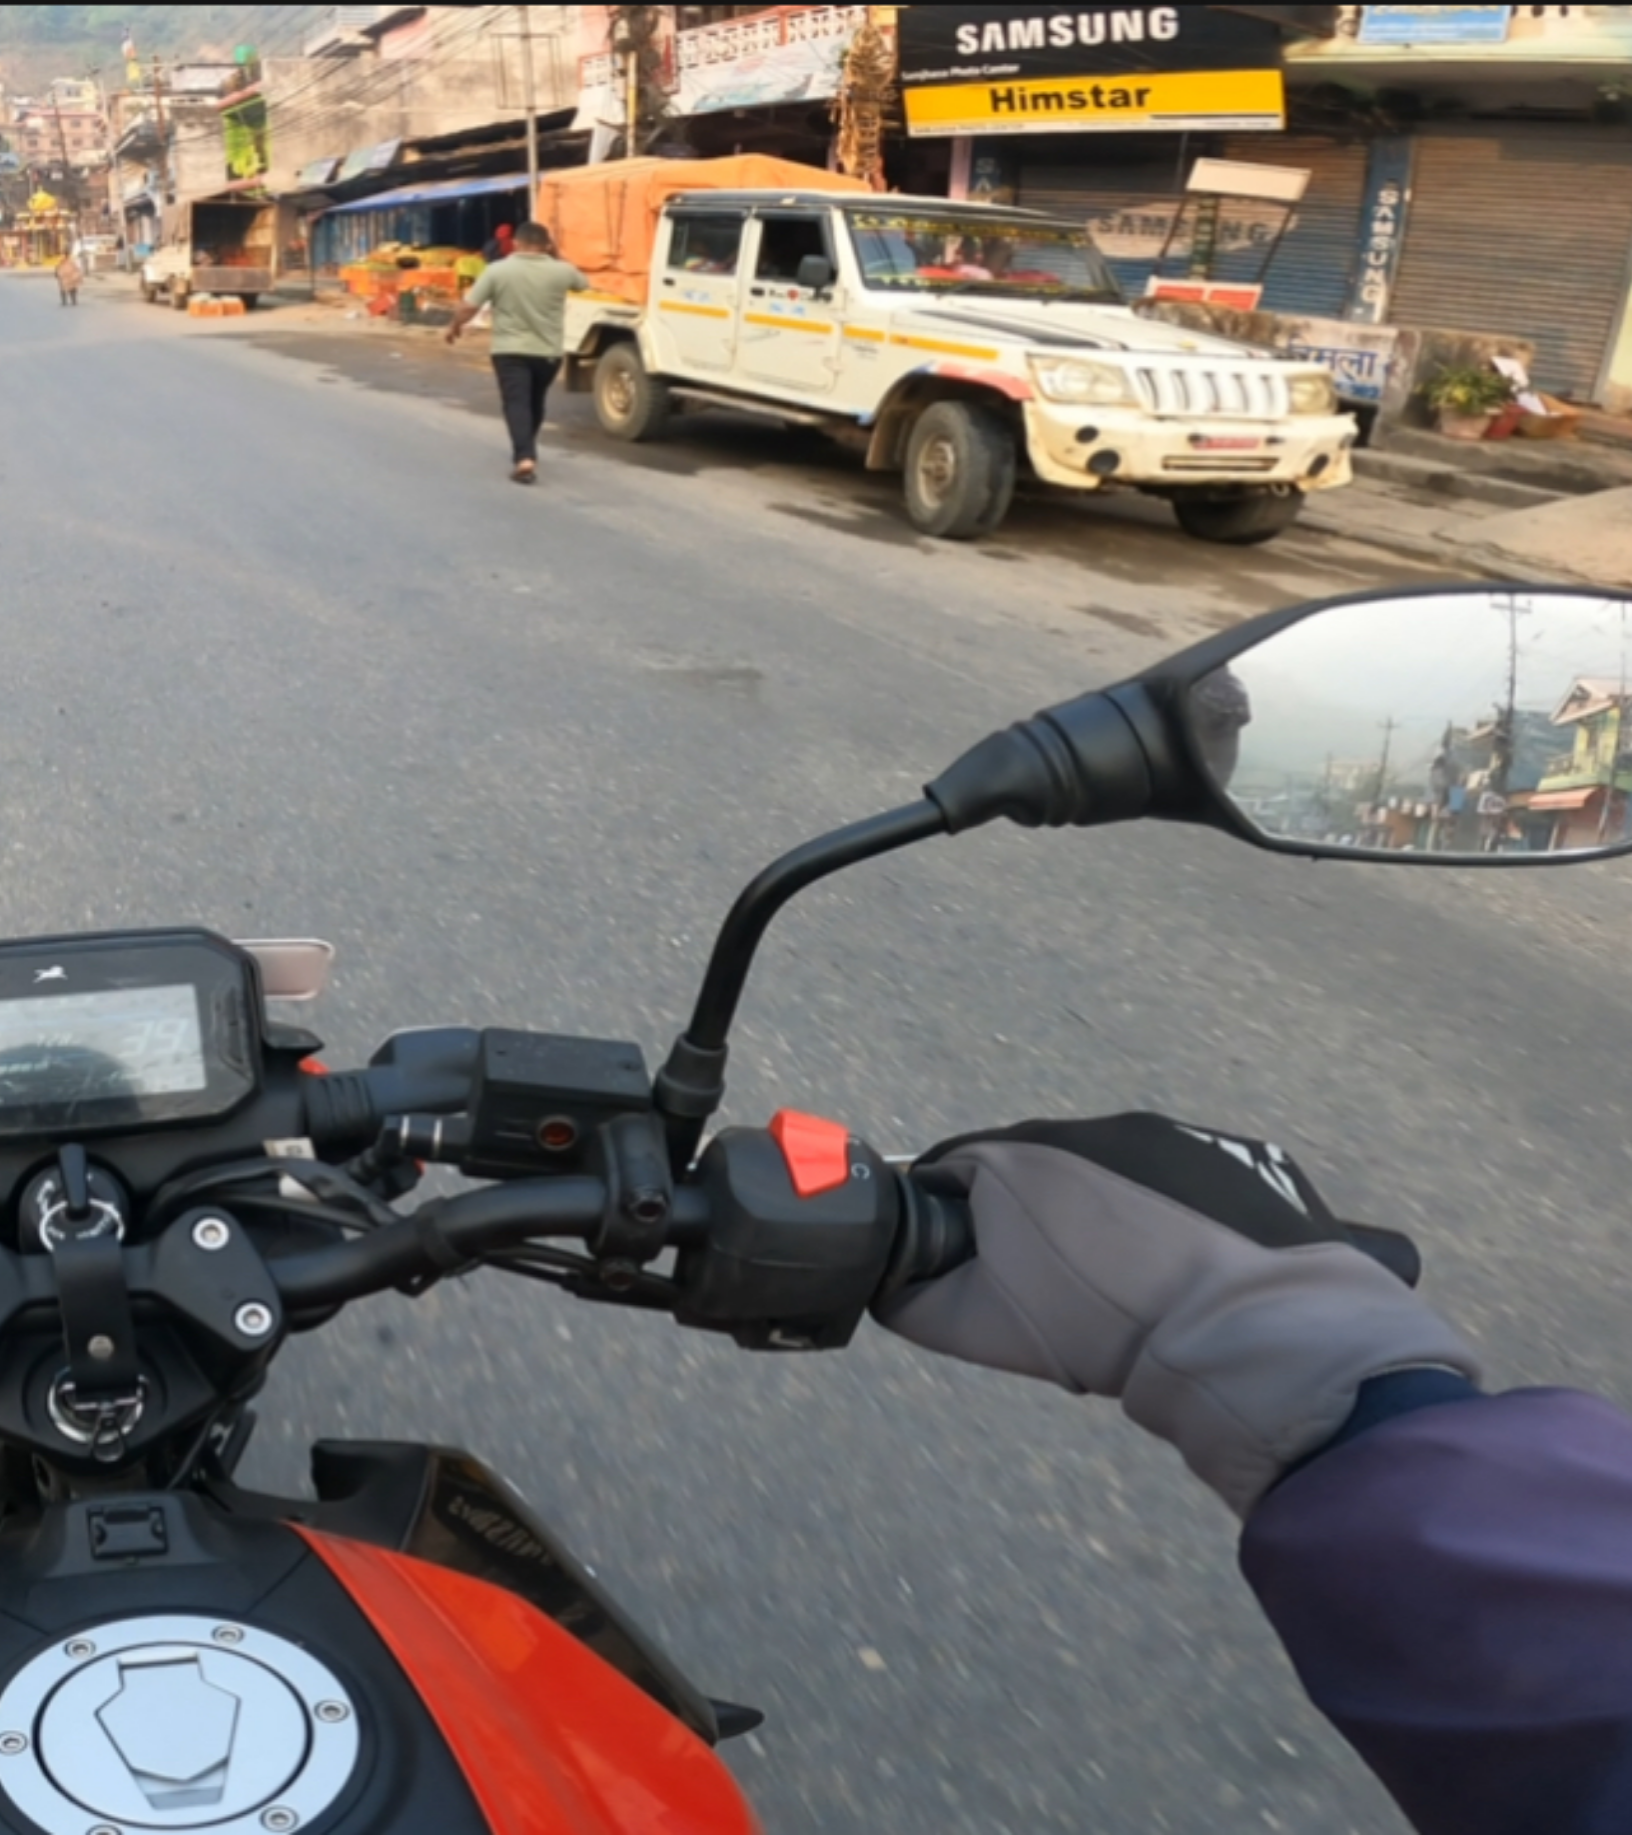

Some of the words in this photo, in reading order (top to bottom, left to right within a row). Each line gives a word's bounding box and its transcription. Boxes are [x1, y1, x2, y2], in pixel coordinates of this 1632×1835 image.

[955, 7, 1180, 55] SAMSUNG
[990, 84, 1152, 113] Himstar
[1097, 212, 1269, 244] SAMNG
[1360, 189, 1400, 304] SAMSUNG
